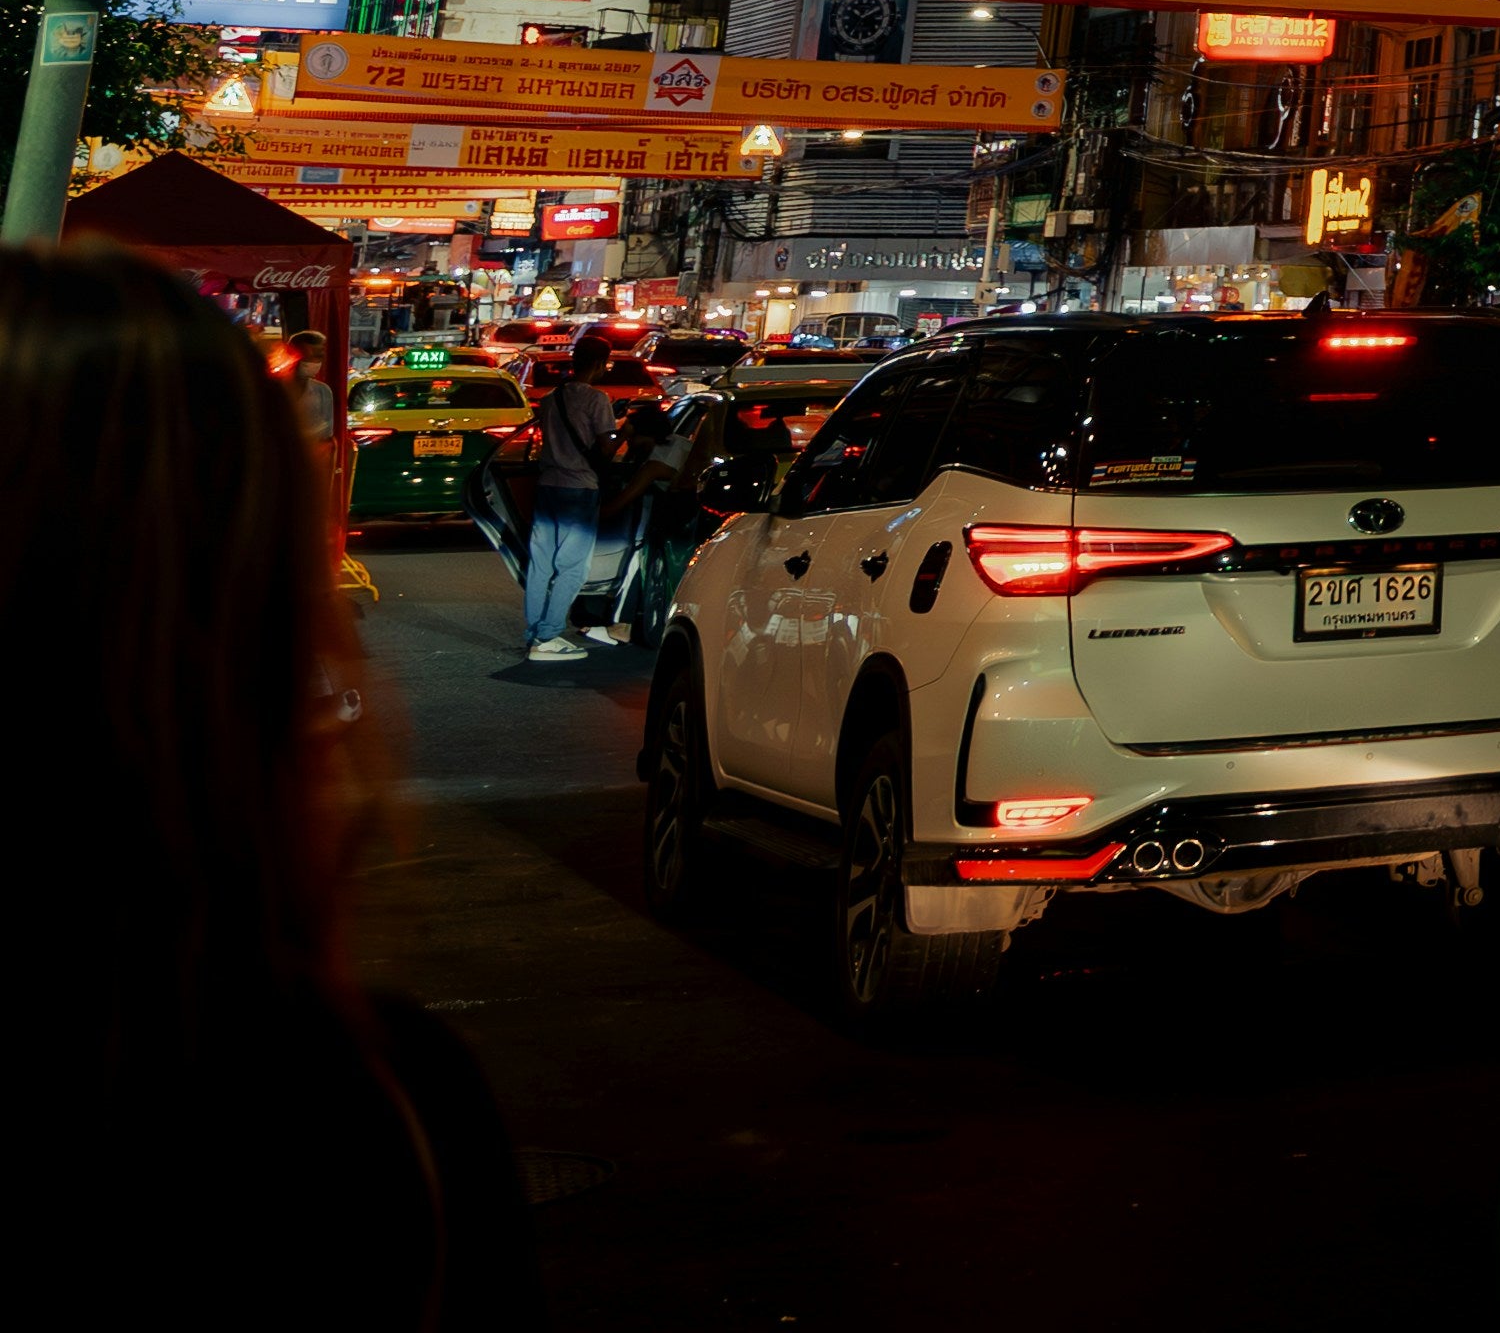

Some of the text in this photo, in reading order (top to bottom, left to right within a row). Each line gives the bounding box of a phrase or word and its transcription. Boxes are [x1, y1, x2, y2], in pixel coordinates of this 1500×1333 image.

[1267, 37, 1327, 47] YAOWARAT
[520, 58, 554, 70] 2-11
[366, 65, 635, 100] 72 พรรษา มหามงคล
[255, 140, 406, 159] พรรษา มหามงคล
[412, 351, 445, 362] TAXI
[1158, 462, 1182, 471] CLUB
[1372, 574, 1432, 603] 1626
[1322, 609, 1416, 630] กรุงเทพมหานคร
